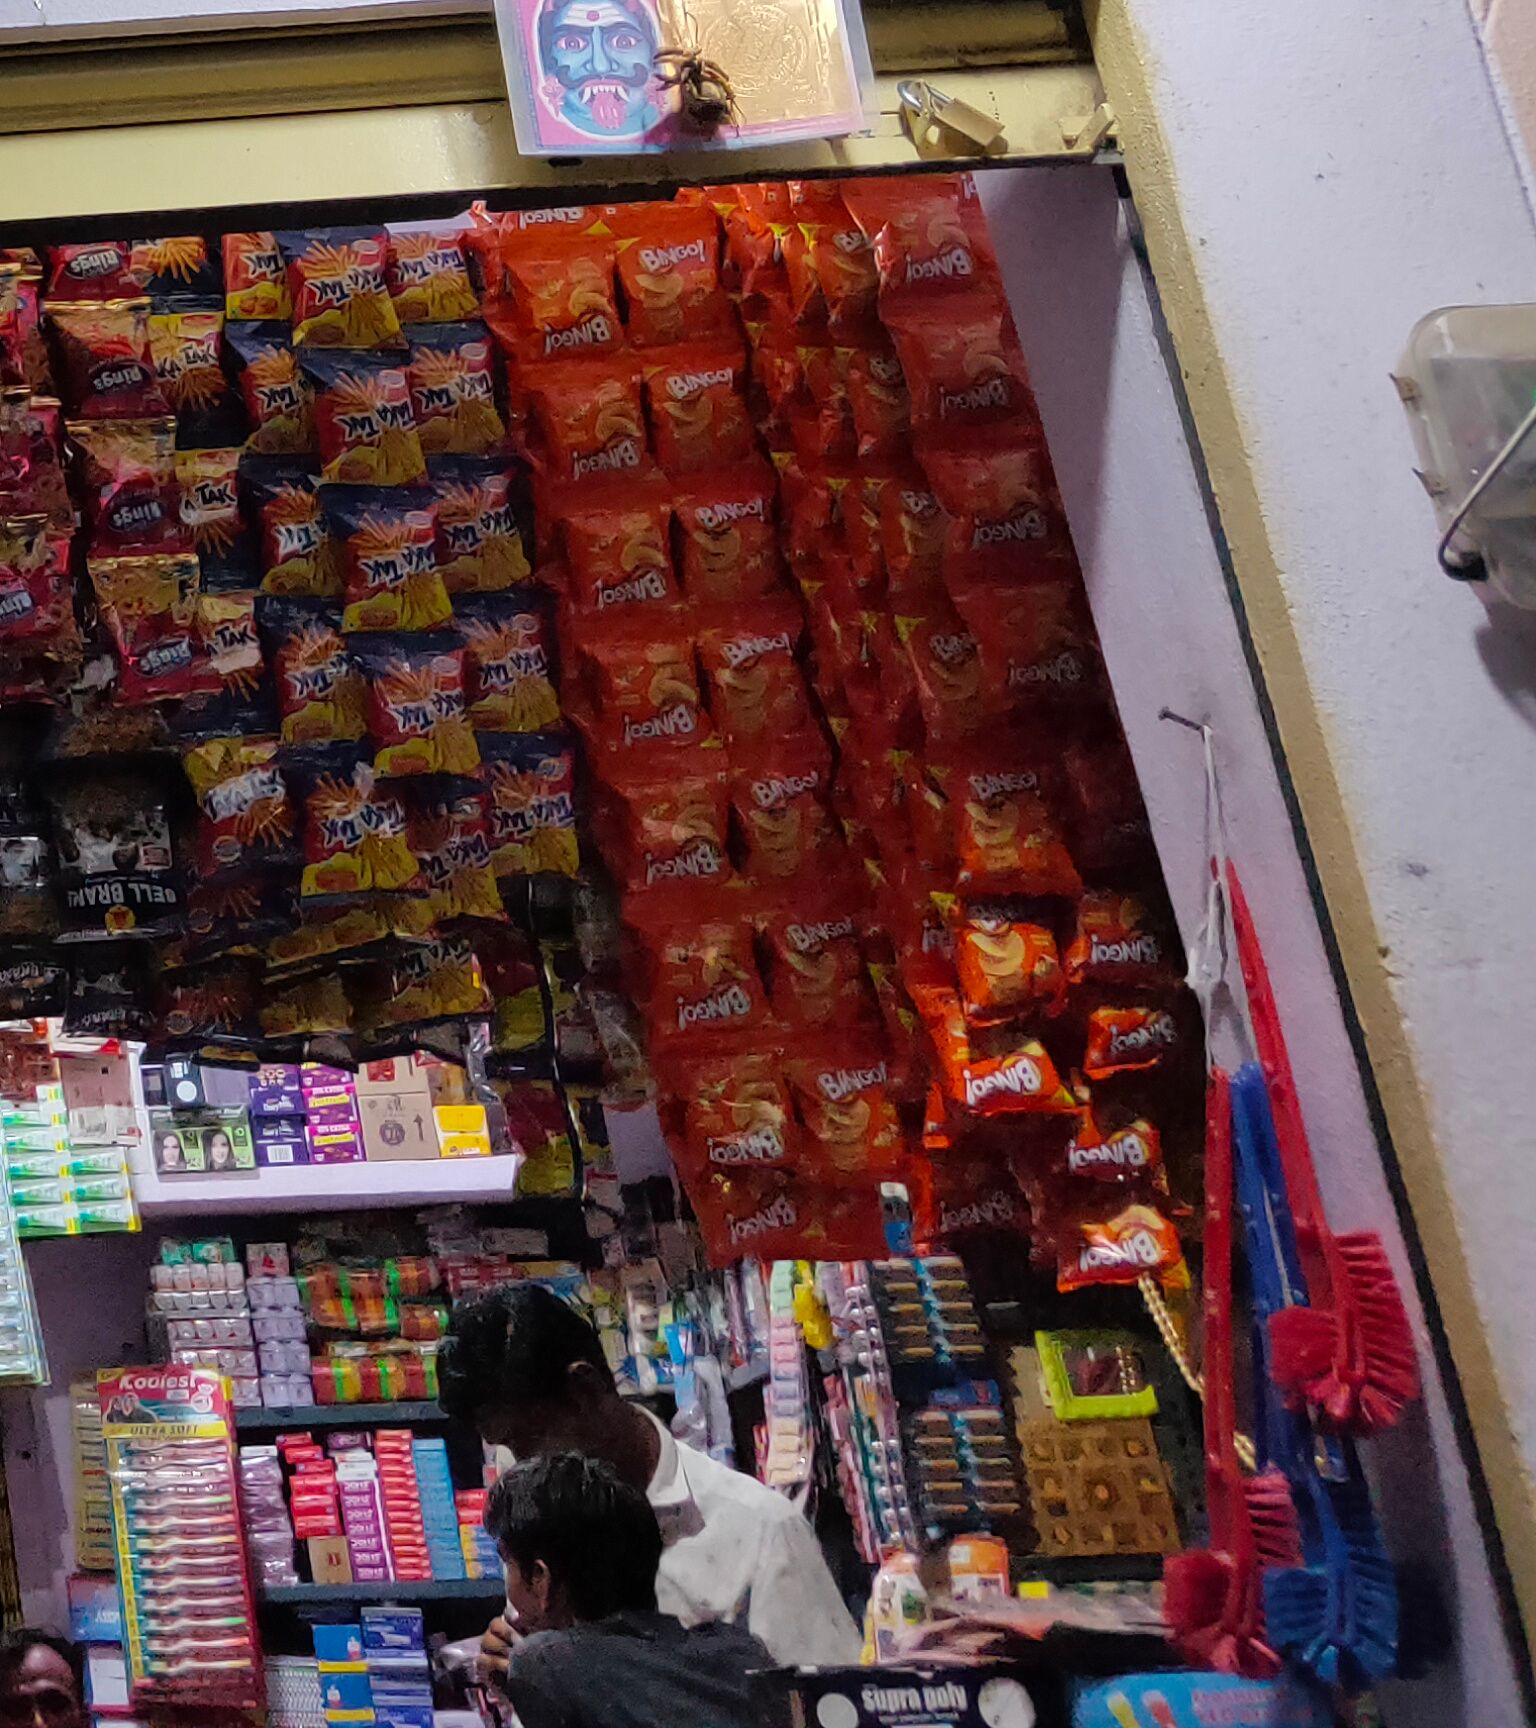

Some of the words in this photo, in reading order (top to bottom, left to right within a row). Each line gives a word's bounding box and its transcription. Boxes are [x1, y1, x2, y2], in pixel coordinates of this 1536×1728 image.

[70, 248, 120, 273] Rings
[637, 238, 706, 273] BINGO!
[905, 246, 974, 284] BINGO!
[543, 313, 611, 356] BINGO!
[92, 365, 145, 391] Rings
[666, 367, 734, 401] BINGO!
[572, 437, 641, 481] BINGO!
[111, 499, 164, 528] Rings
[693, 497, 764, 530] BINGO!
[596, 568, 667, 611] BINGO!
[724, 631, 794, 669] BINGO!
[623, 702, 696, 747] BINGO!
[751, 770, 819, 809] BINGO!
[785, 914, 855, 951] BINGO!
[676, 984, 752, 1030] BINGO!
[817, 1060, 888, 1102] BINGO!
[964, 1062, 1042, 1108] BINGO!
